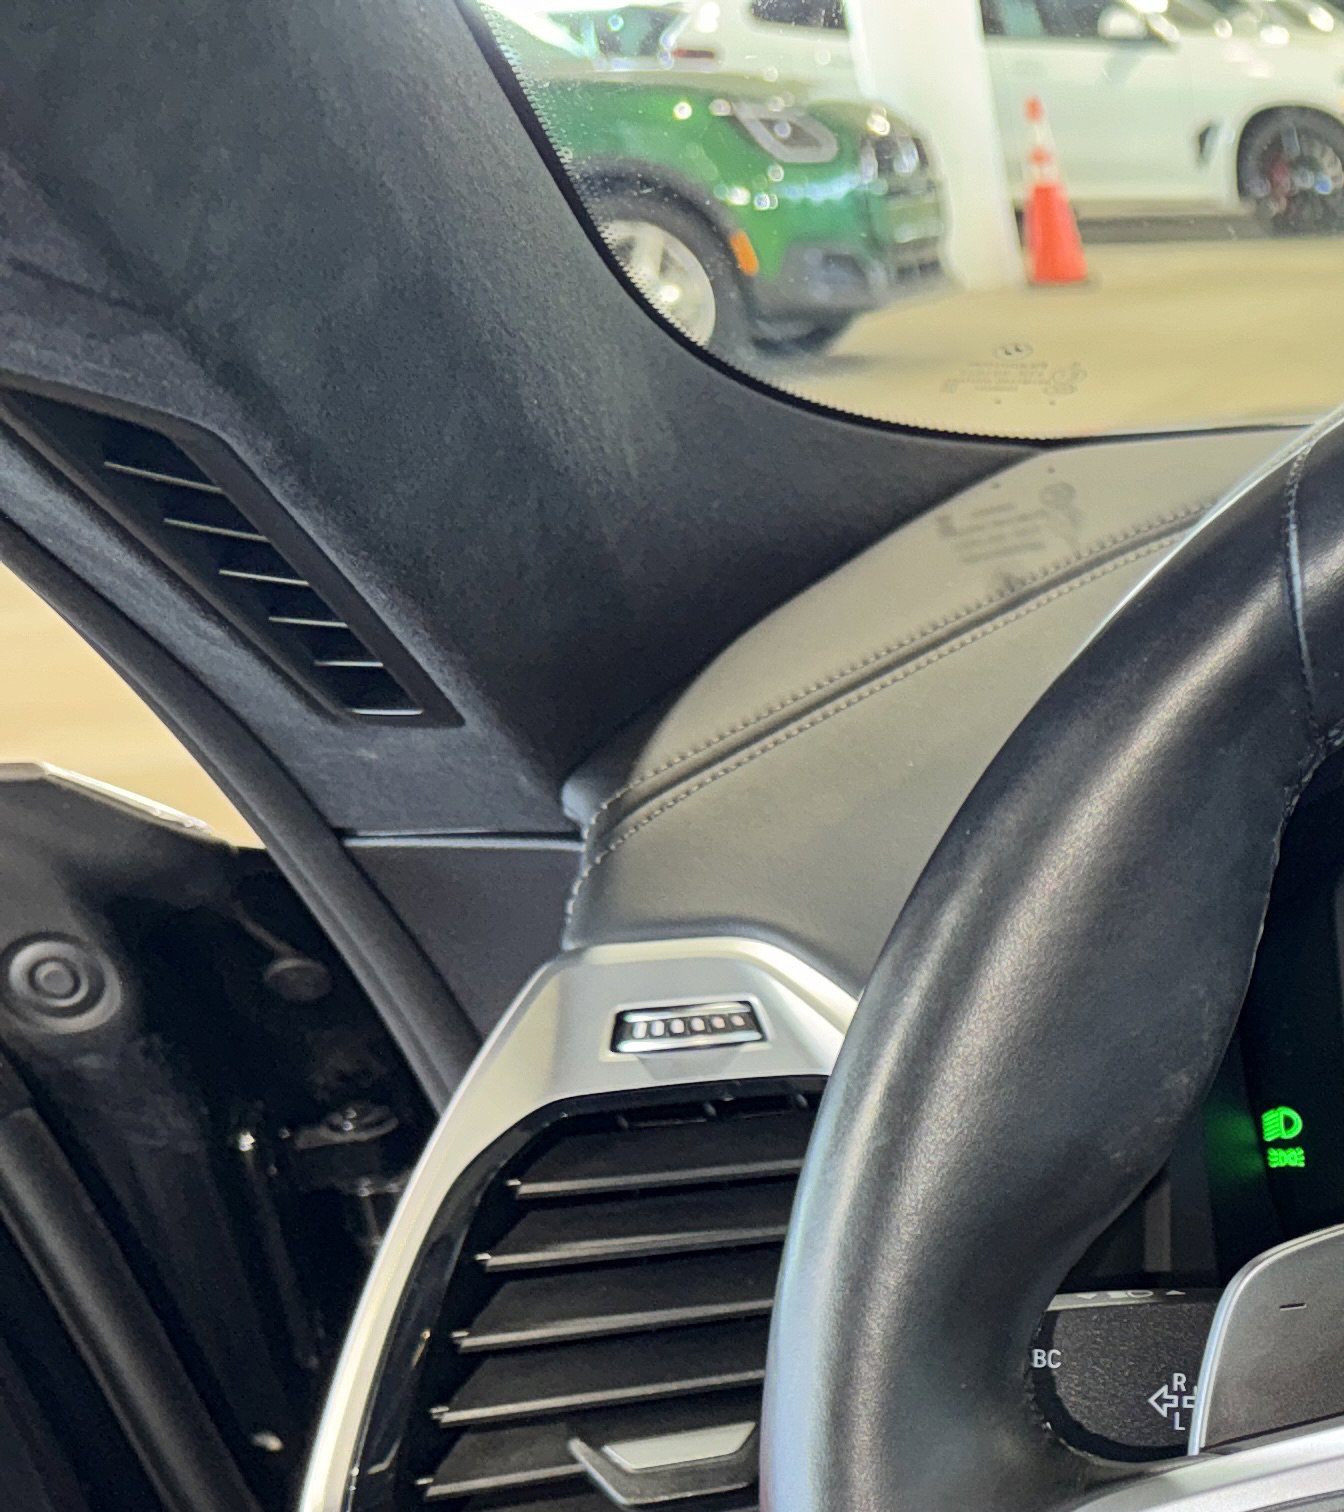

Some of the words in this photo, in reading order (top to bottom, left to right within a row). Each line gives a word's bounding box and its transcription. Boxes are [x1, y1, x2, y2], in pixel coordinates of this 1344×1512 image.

[1031, 1349, 1062, 1369] BC
[1173, 1372, 1187, 1392] R
[1174, 1413, 1186, 1431] L
